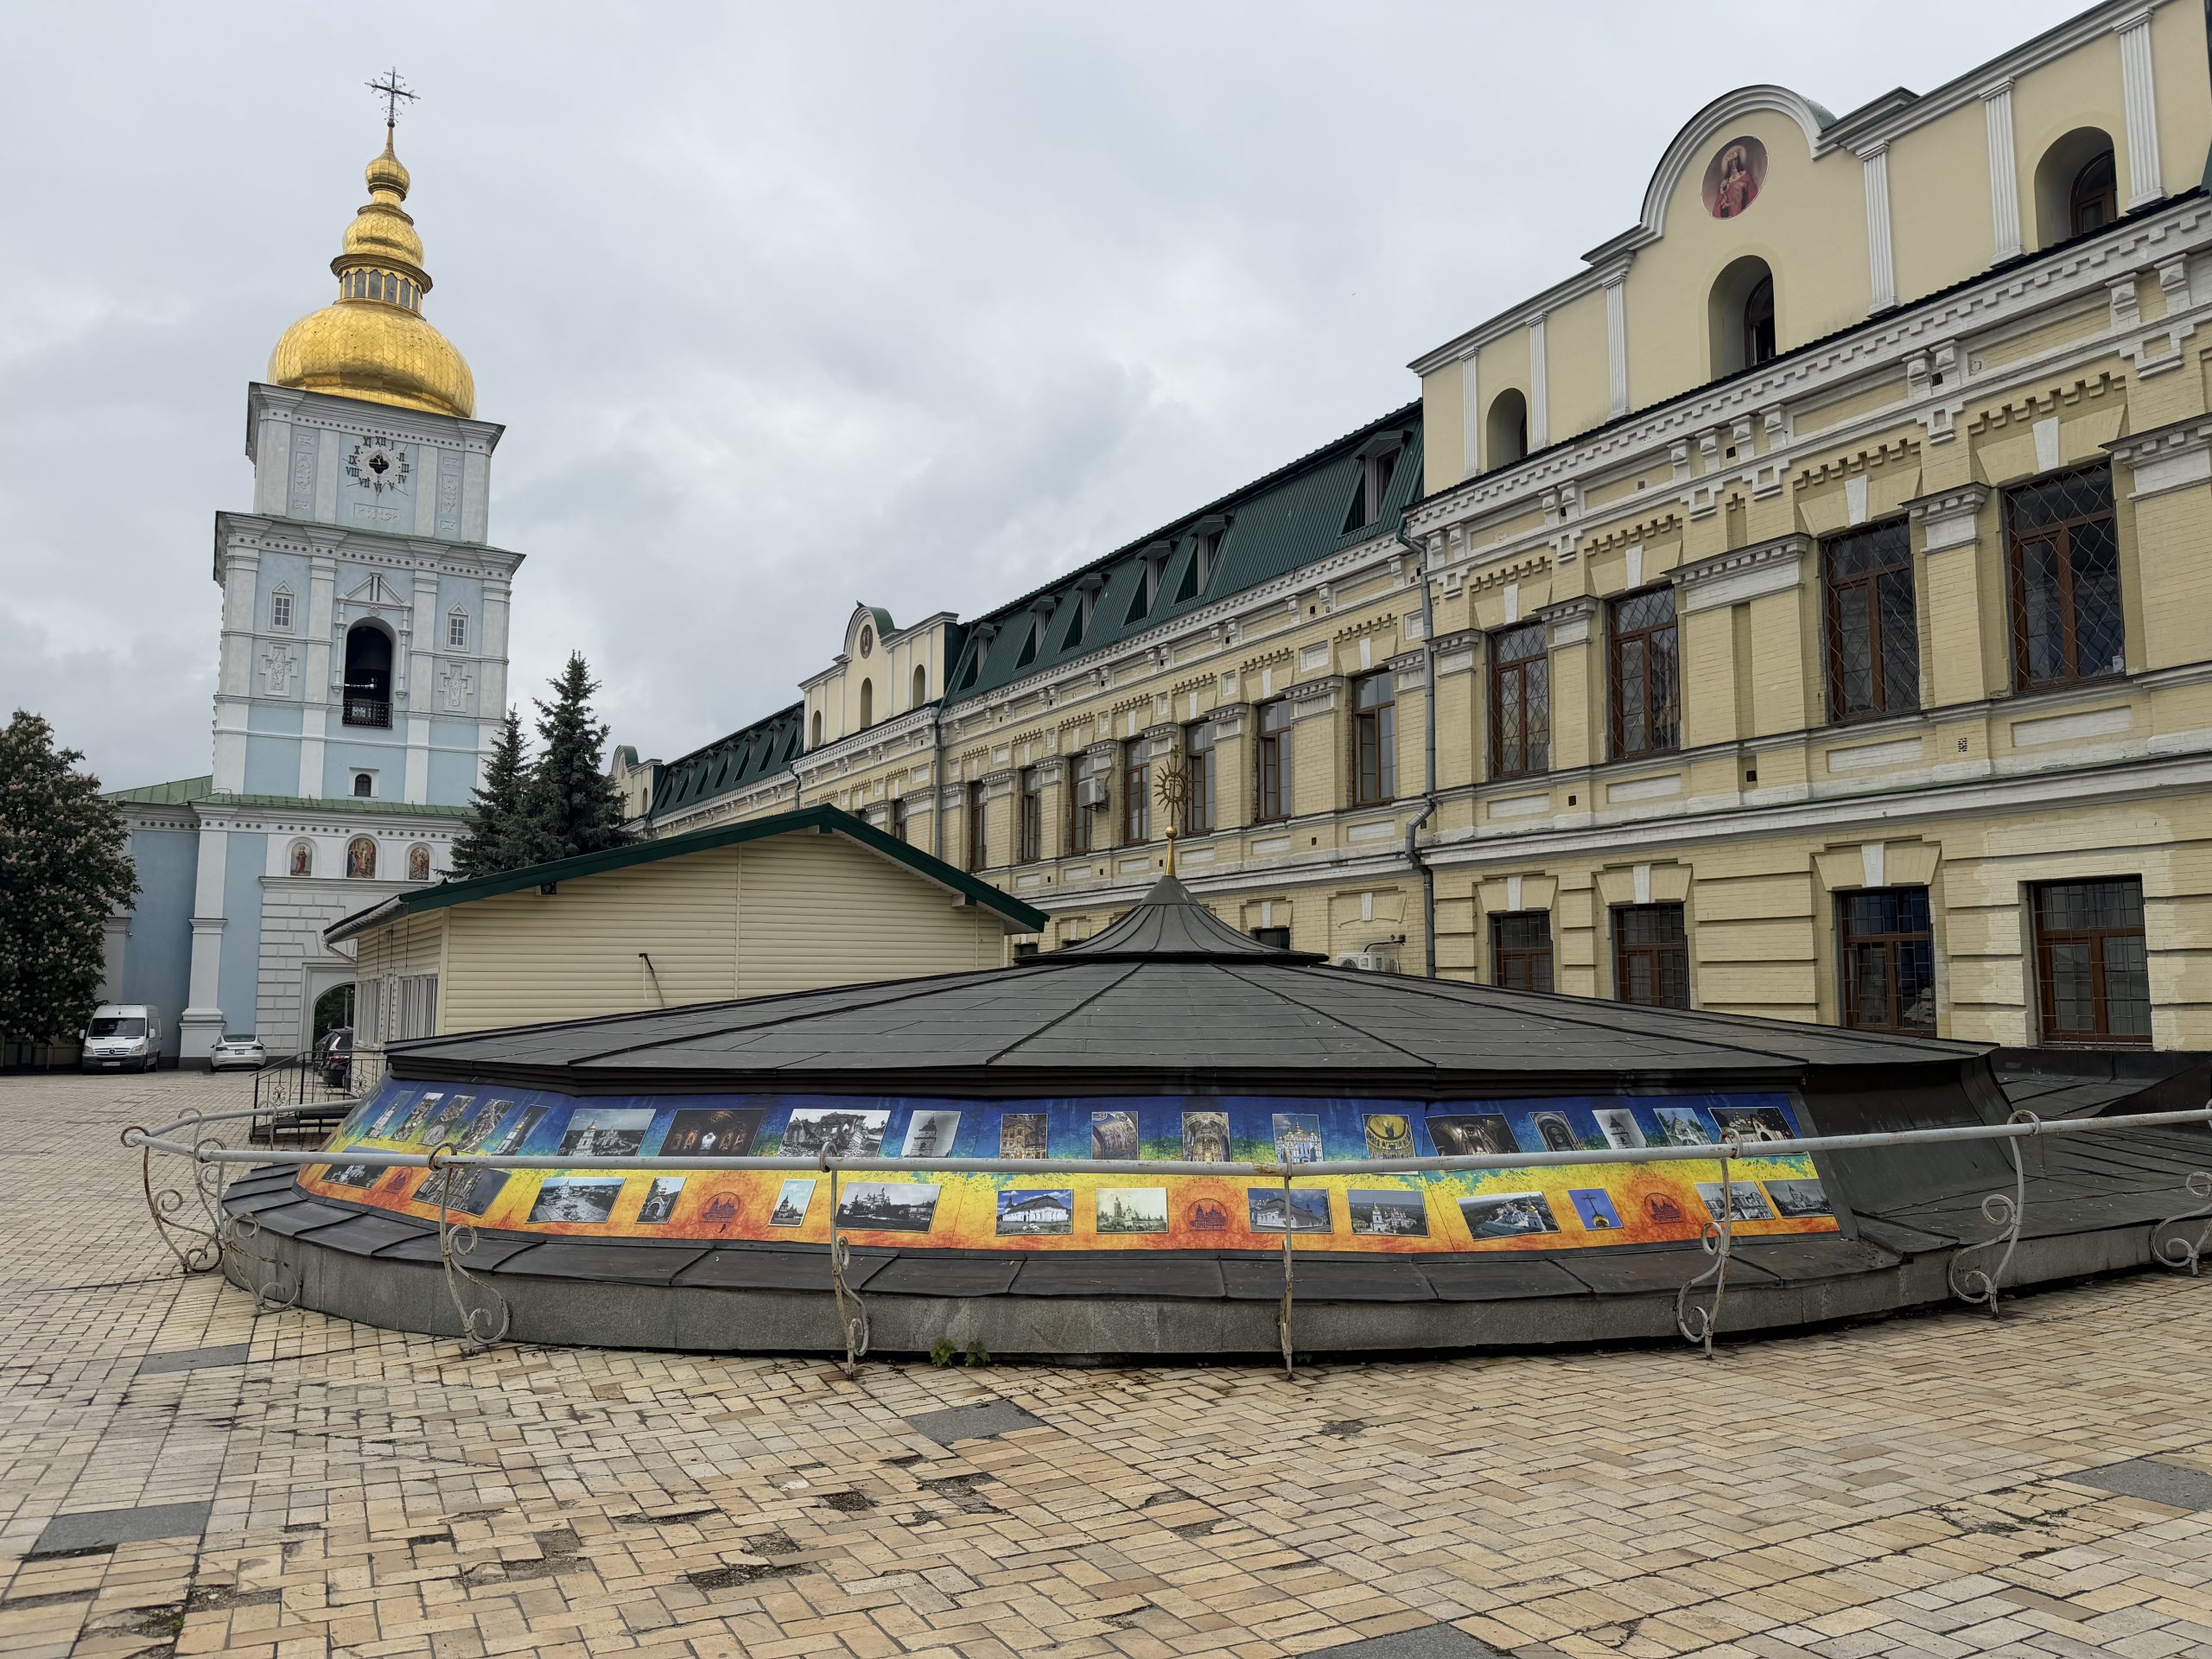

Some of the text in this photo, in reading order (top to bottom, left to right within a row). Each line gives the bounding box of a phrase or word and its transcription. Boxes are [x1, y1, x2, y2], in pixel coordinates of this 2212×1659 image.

[363, 437, 371, 448] XI
[375, 436, 386, 446] XII
[354, 445, 360, 454] X
[349, 455, 357, 464] IX
[399, 453, 404, 461] II
[346, 467, 359, 477] VIII
[398, 474, 406, 484] IV
[389, 482, 394, 491] V
